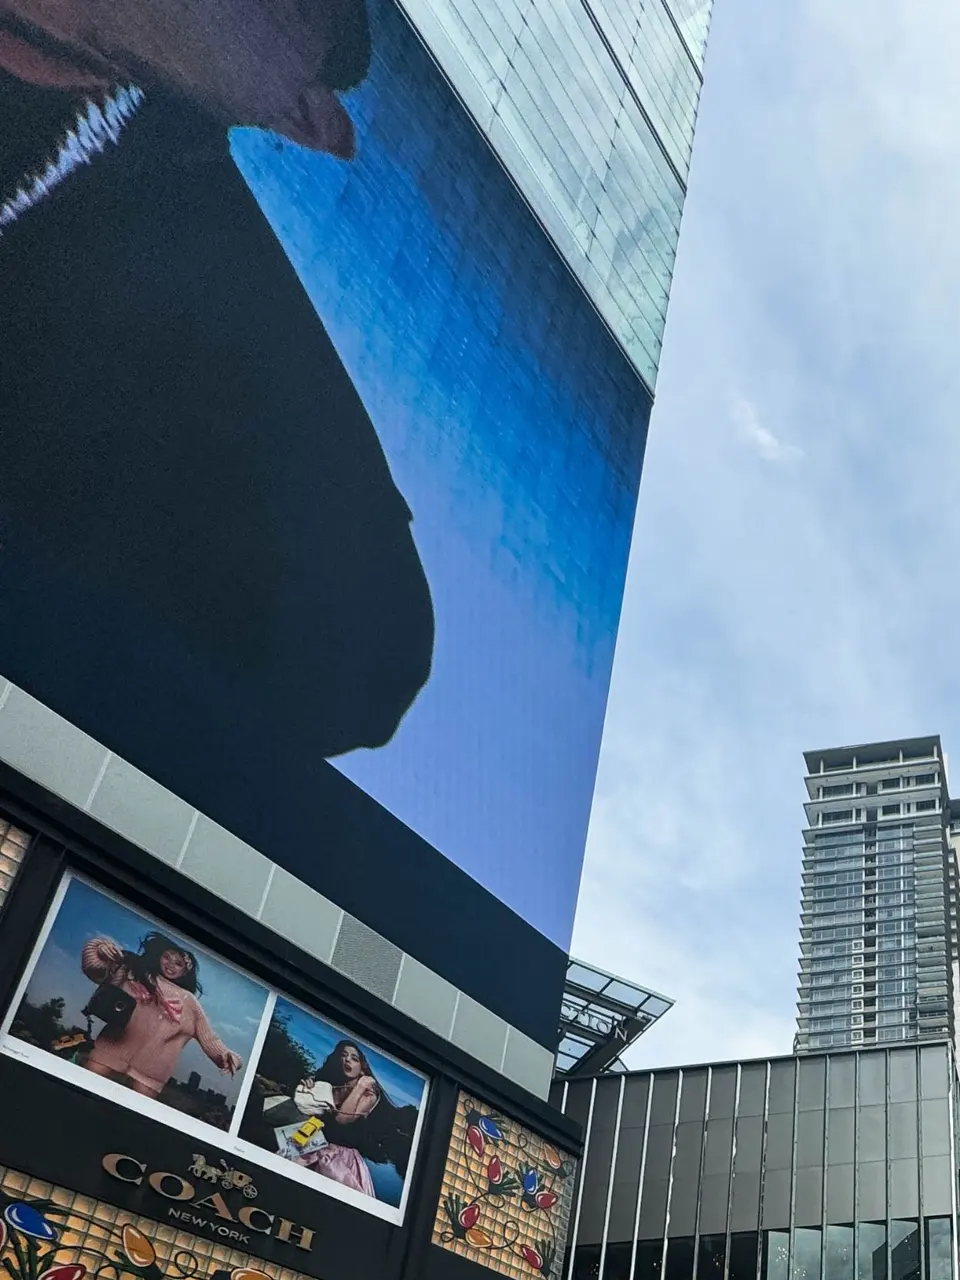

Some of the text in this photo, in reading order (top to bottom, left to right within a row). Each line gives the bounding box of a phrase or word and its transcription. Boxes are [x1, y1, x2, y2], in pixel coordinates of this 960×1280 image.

[101, 1152, 317, 1252] COACH
[167, 1207, 251, 1245] NEW YORK
